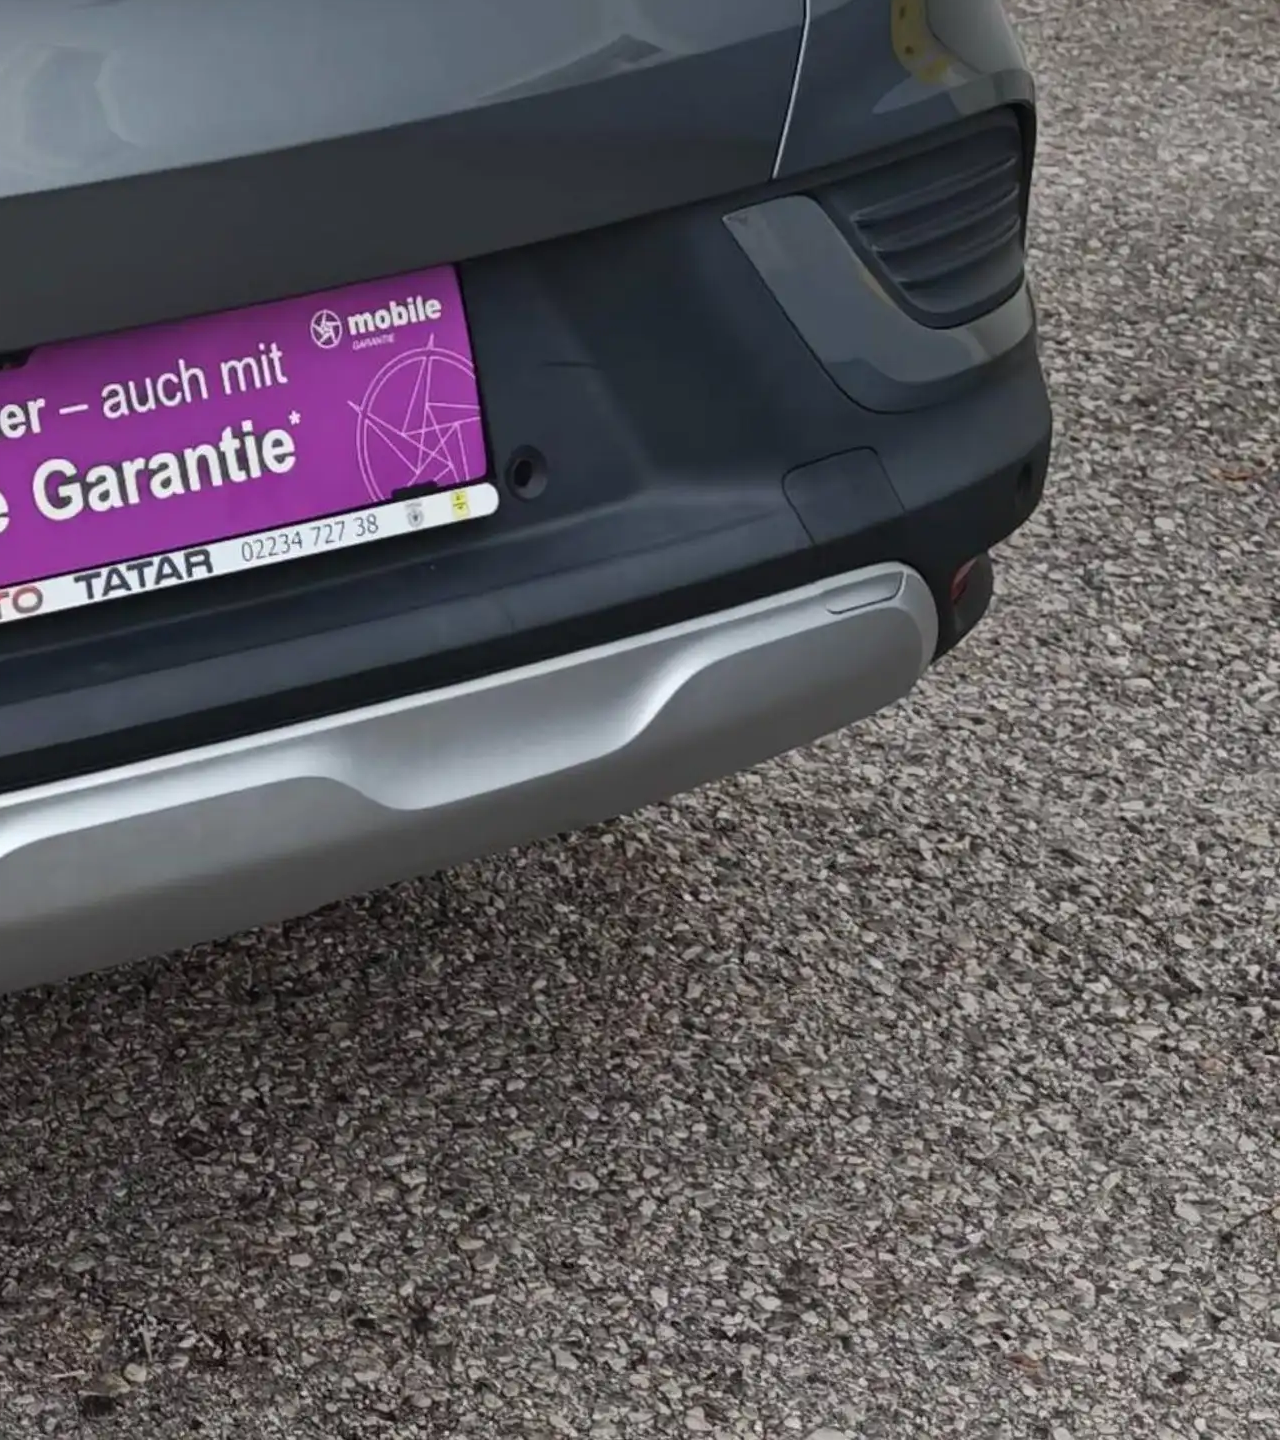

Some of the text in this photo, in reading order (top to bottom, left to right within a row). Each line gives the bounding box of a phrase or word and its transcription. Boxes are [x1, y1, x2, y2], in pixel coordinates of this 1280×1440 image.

[346, 295, 442, 336] mobile
[100, 358, 210, 420] auch
[220, 342, 289, 396] mit
[73, 548, 214, 601] TATAR
[241, 531, 303, 563] 02234
[309, 519, 347, 547] 727
[355, 513, 380, 538] 38
